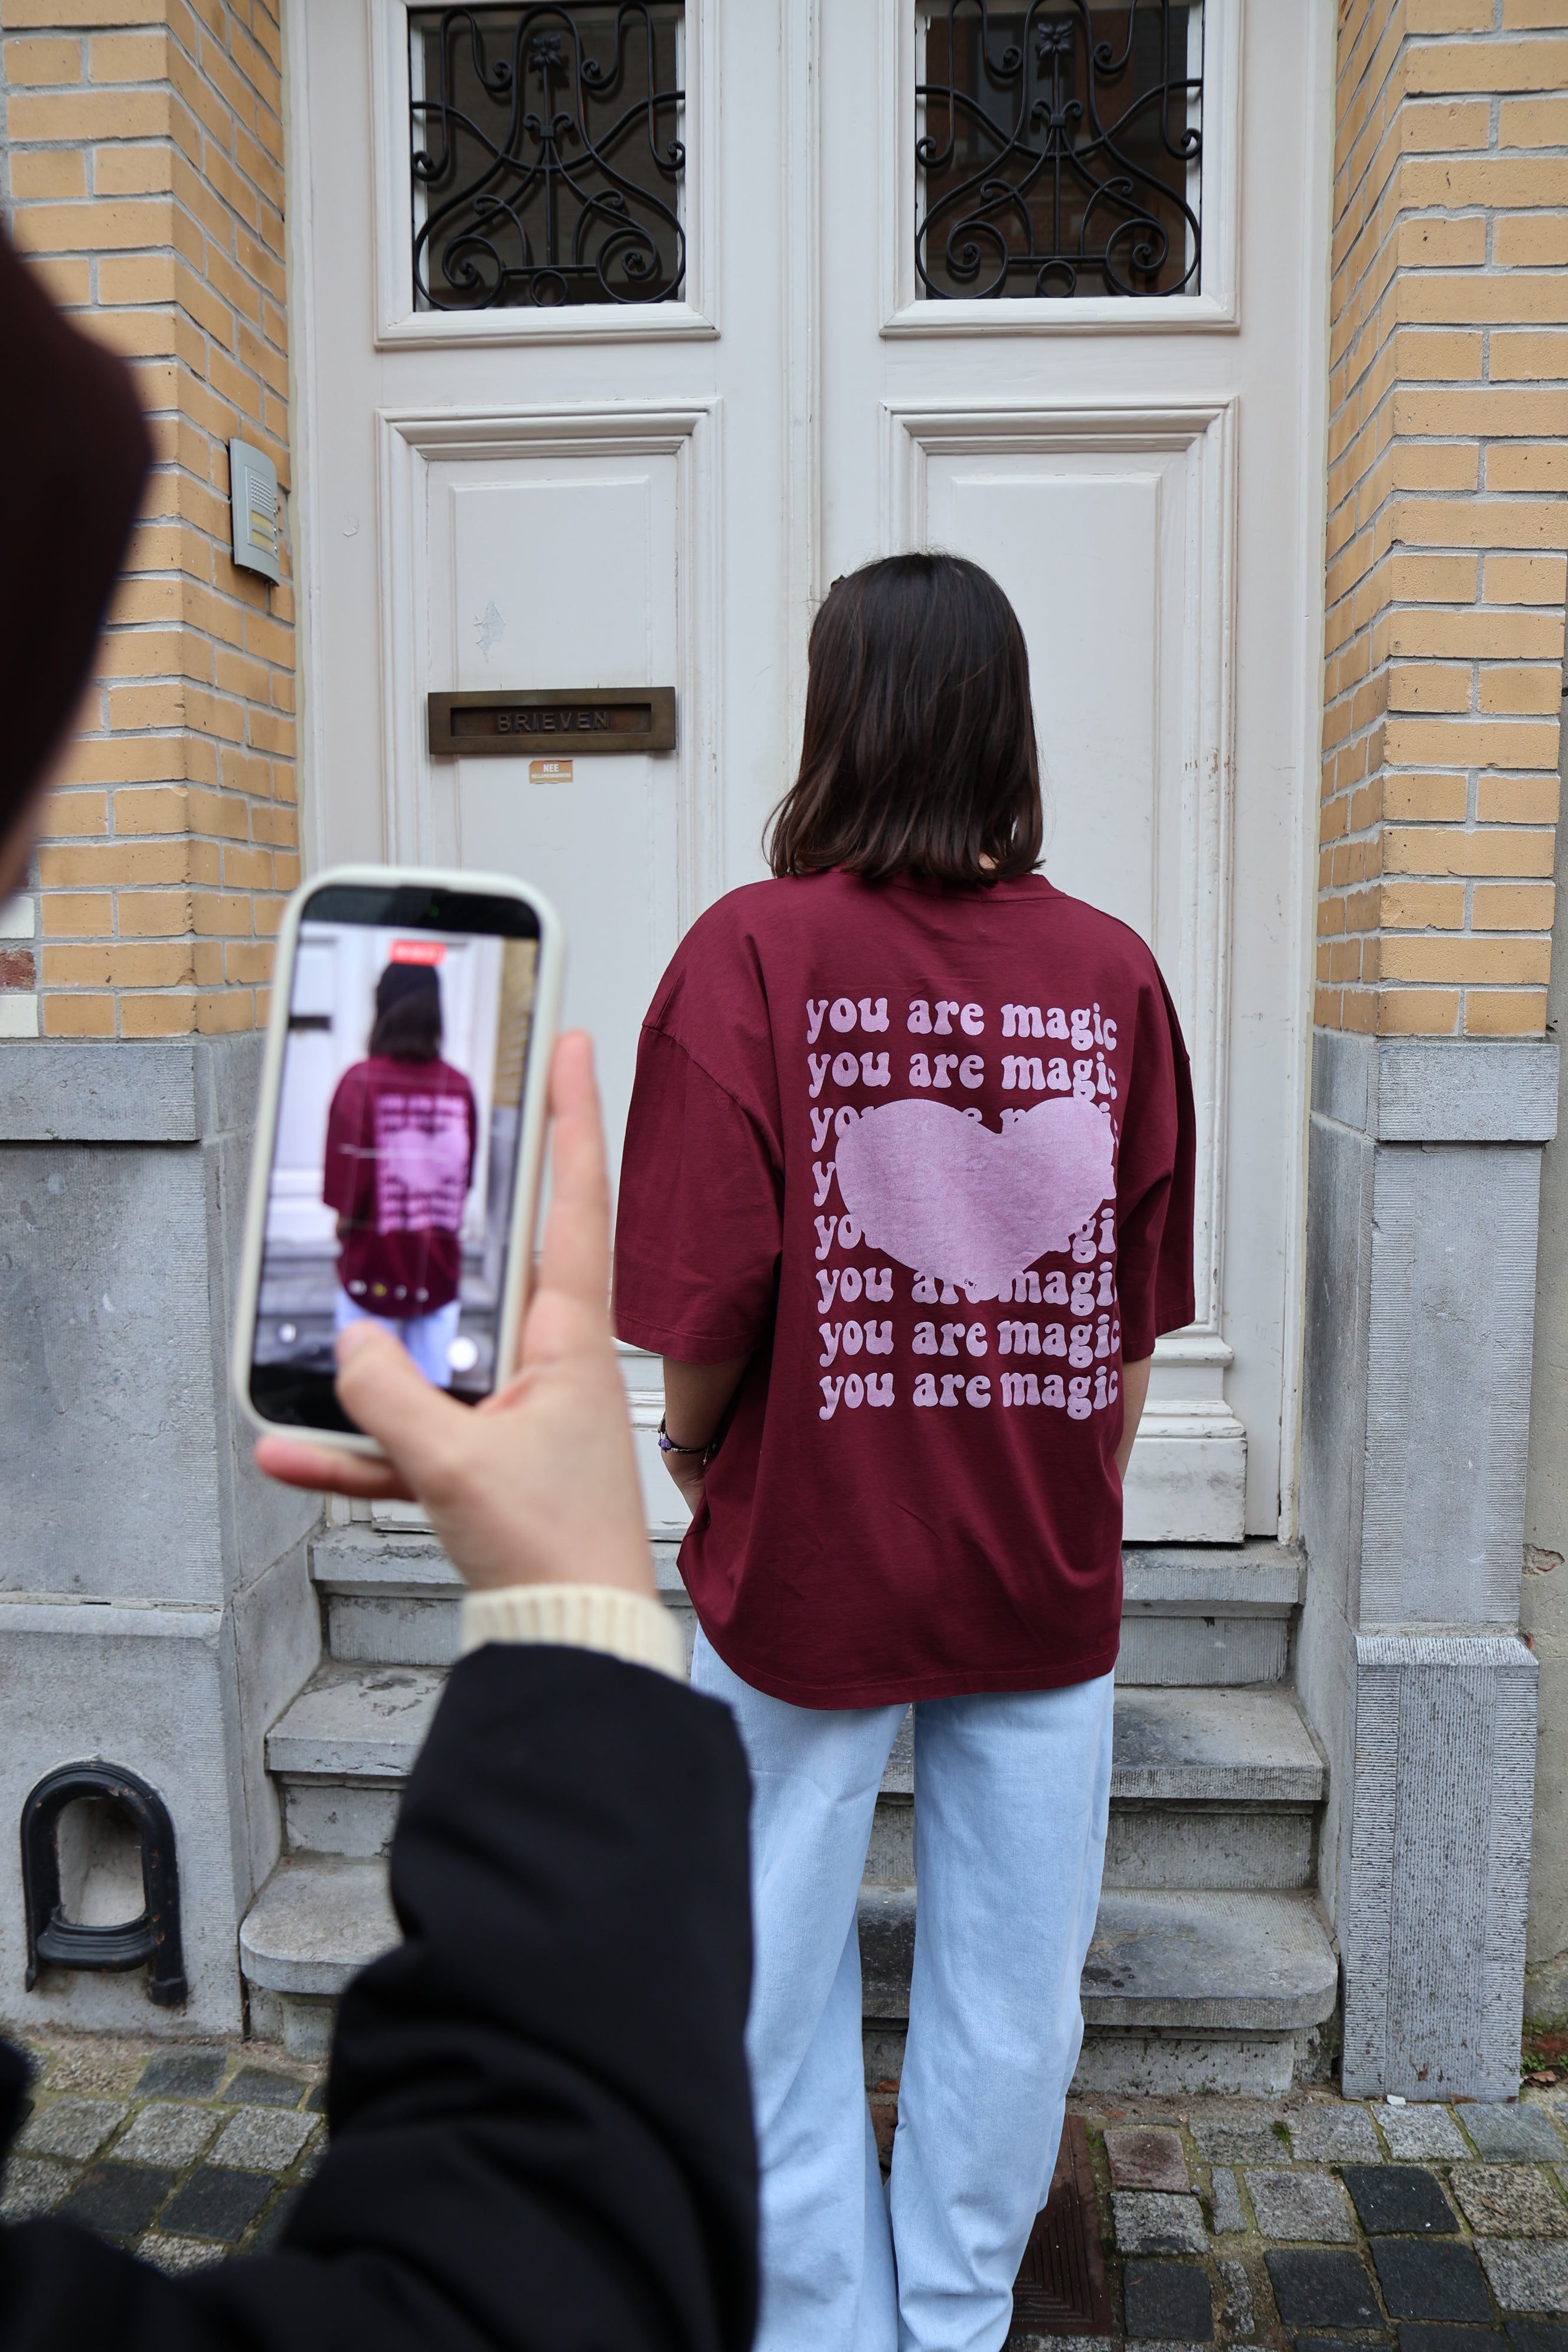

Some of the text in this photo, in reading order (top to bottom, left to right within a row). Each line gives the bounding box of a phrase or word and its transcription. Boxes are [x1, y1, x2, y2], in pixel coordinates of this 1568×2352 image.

[498, 711, 609, 733] BRIEVEN
[543, 763, 559, 773] NEE
[806, 998, 1117, 1051] you are magic
[808, 1051, 1118, 1102] you are magic
[810, 1106, 874, 1152] yo
[814, 1214, 880, 1260] yo
[816, 1268, 893, 1314] you
[998, 1262, 1118, 1316] magi
[819, 1314, 1119, 1368] you are magic
[819, 1366, 1118, 1420] you are magic
